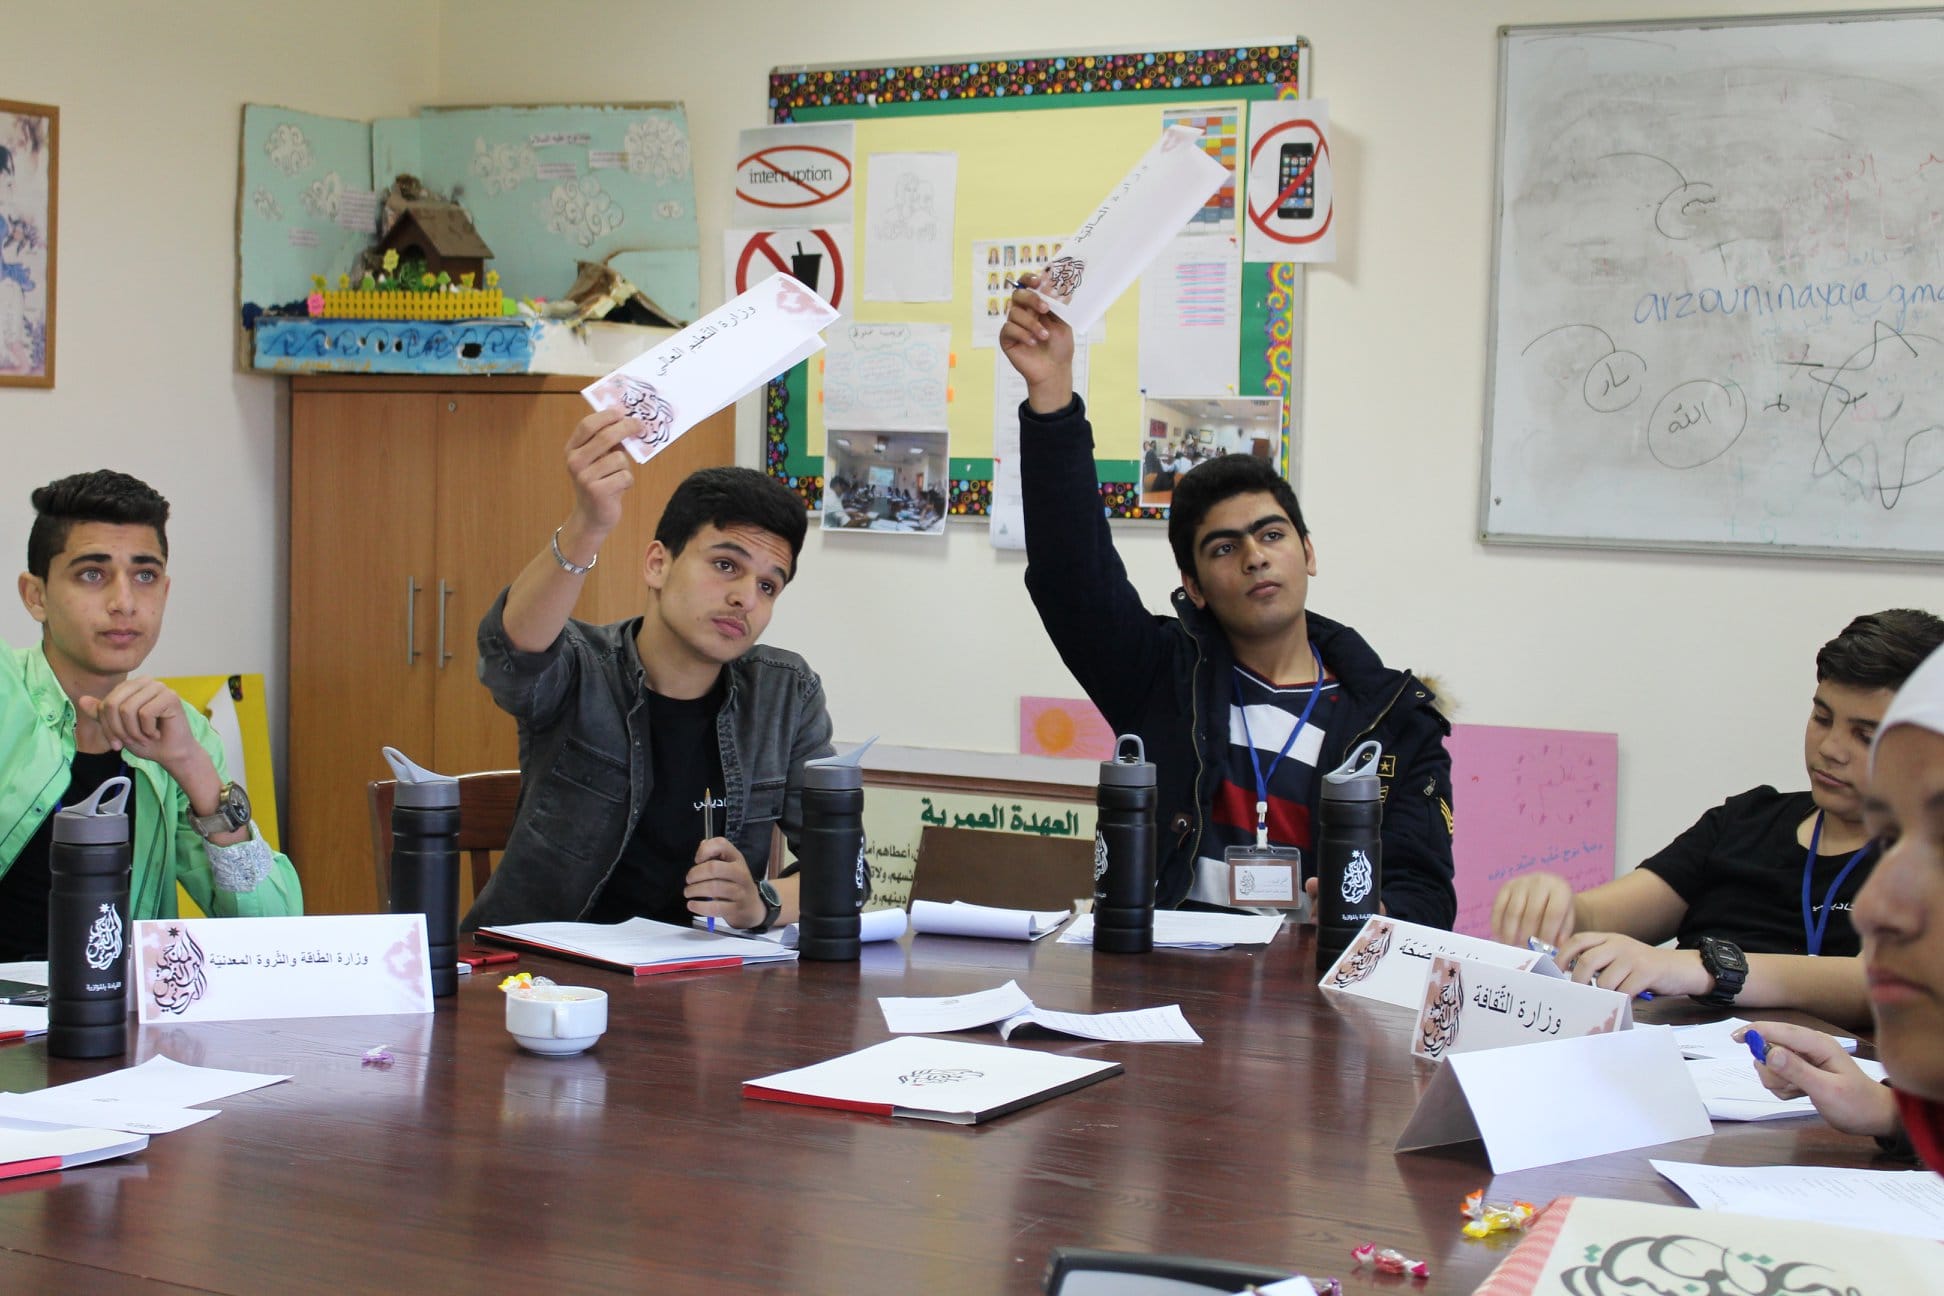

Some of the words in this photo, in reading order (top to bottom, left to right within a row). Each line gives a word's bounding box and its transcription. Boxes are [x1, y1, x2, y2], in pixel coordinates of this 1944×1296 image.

[750, 165, 833, 185] interruption
[718, 306, 757, 328] وزارة
[657, 346, 685, 376] العالي
[921, 798, 1004, 829] العمرية
[1010, 804, 1079, 836] العهدة
[337, 952, 368, 966] وزارة
[1517, 1000, 1561, 1035] وزارة
